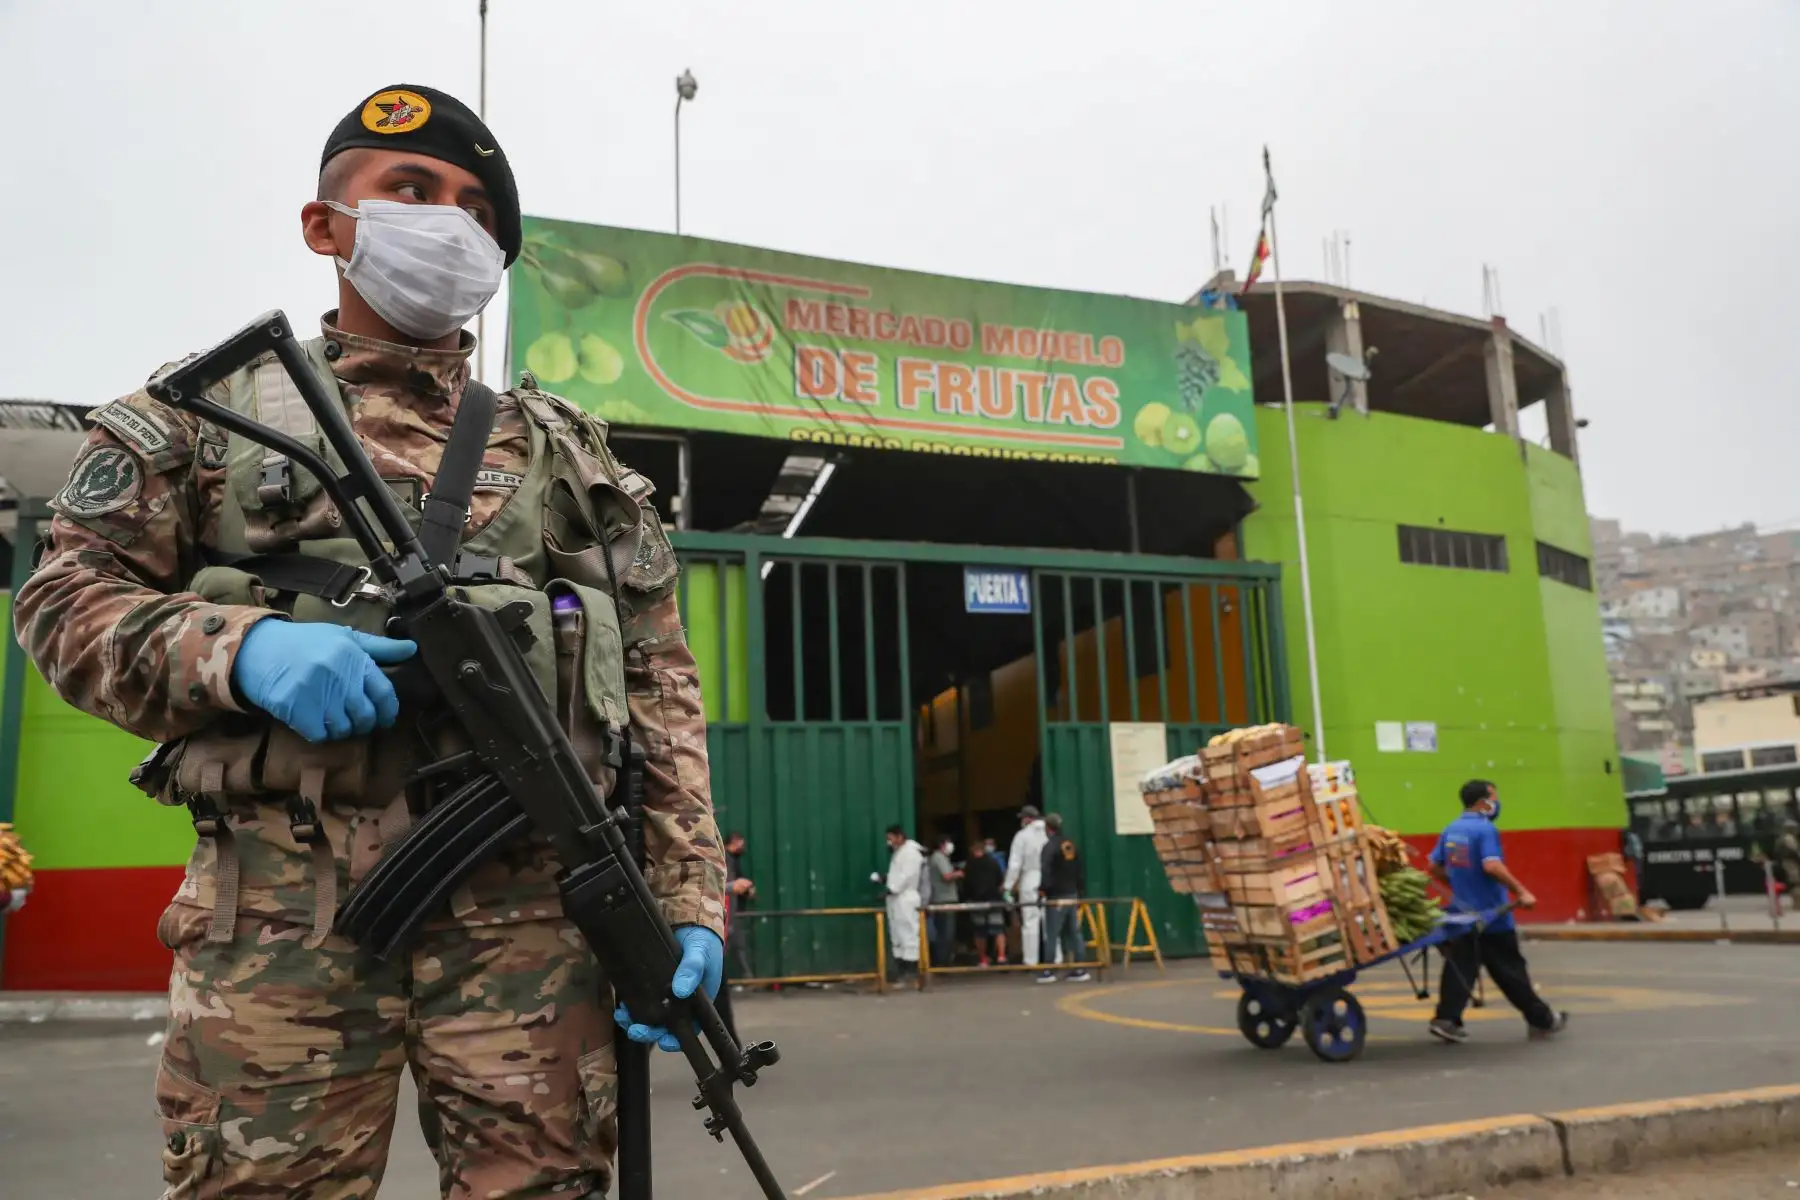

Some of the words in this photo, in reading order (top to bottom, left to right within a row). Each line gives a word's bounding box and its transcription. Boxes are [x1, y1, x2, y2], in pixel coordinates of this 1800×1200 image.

[786, 297, 973, 351] MERCADO
[981, 323, 1124, 368] MODELO
[794, 344, 880, 405] DE
[896, 356, 1121, 429] FRUTAS
[138, 426, 162, 446] PERU
[967, 573, 1020, 605] PUERTA
